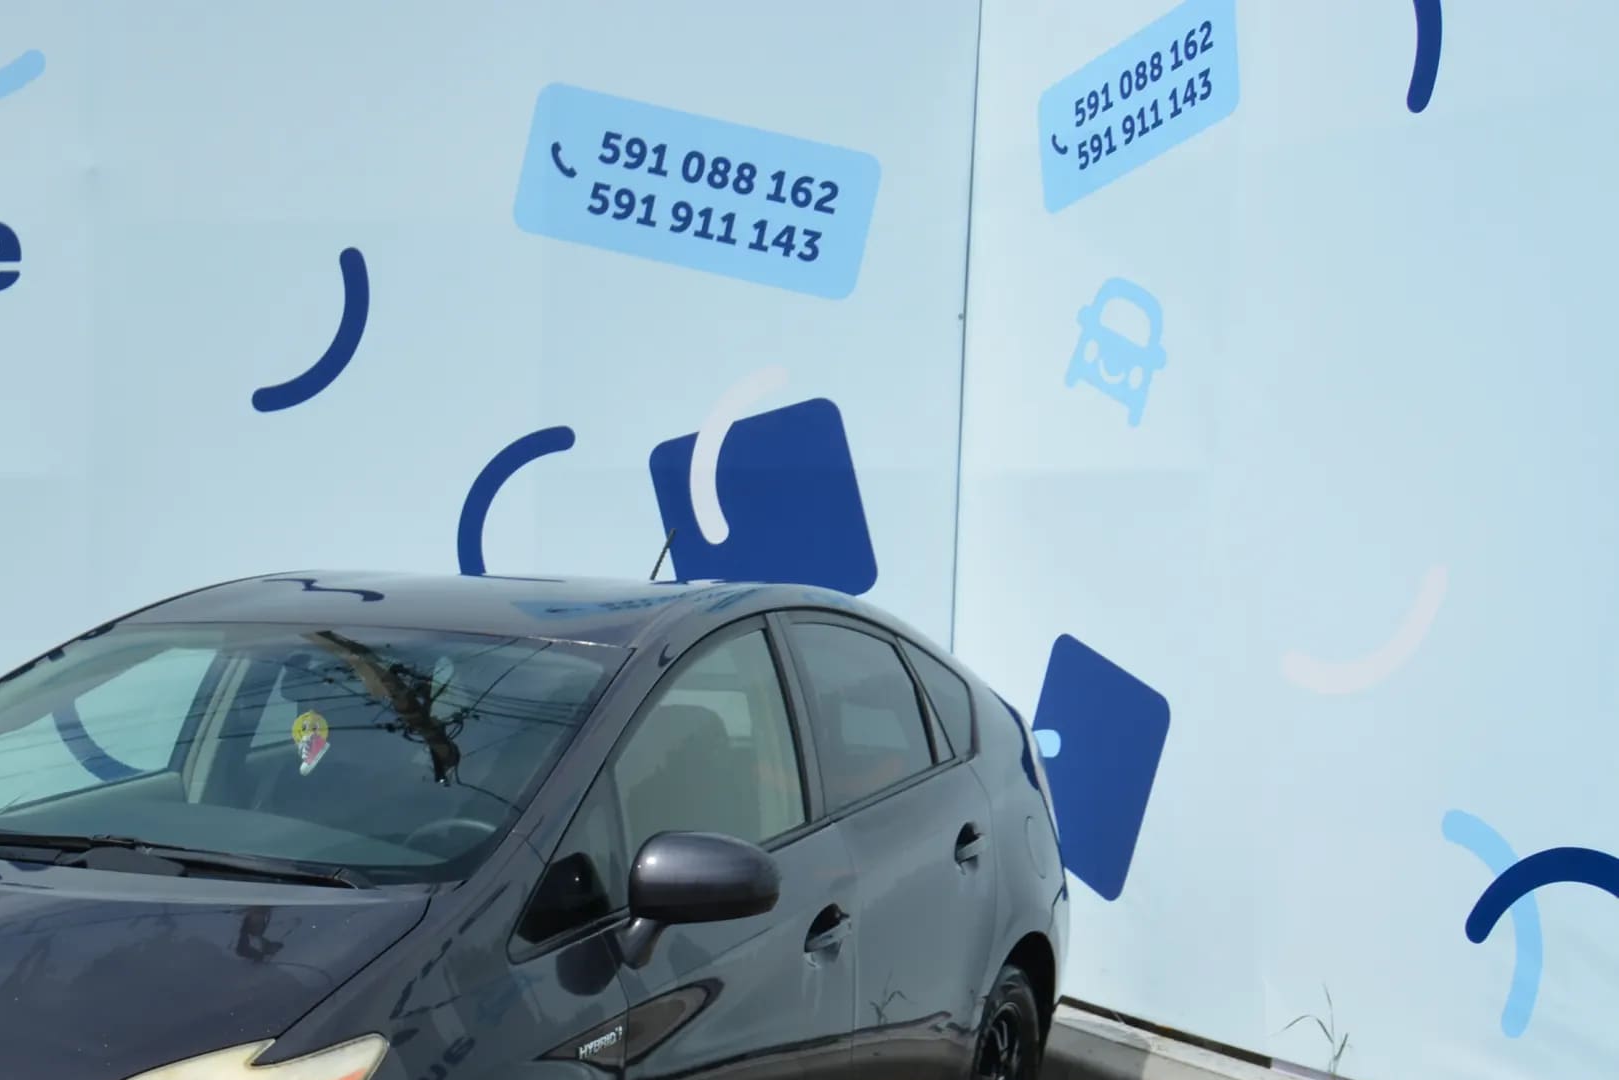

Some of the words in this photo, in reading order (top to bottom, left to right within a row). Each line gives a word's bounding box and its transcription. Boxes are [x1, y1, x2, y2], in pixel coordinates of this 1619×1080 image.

[1074, 82, 1114, 128] 591
[1119, 51, 1163, 100] 088
[1169, 20, 1214, 72] 162
[1077, 125, 1117, 171] 591
[1121, 98, 1164, 146] 911
[1168, 67, 1213, 119] 143
[597, 130, 669, 178] 591
[681, 150, 758, 196] 088
[765, 170, 840, 215] 162
[586, 181, 657, 228] 591
[669, 200, 738, 246] 911
[747, 219, 823, 263] 143
